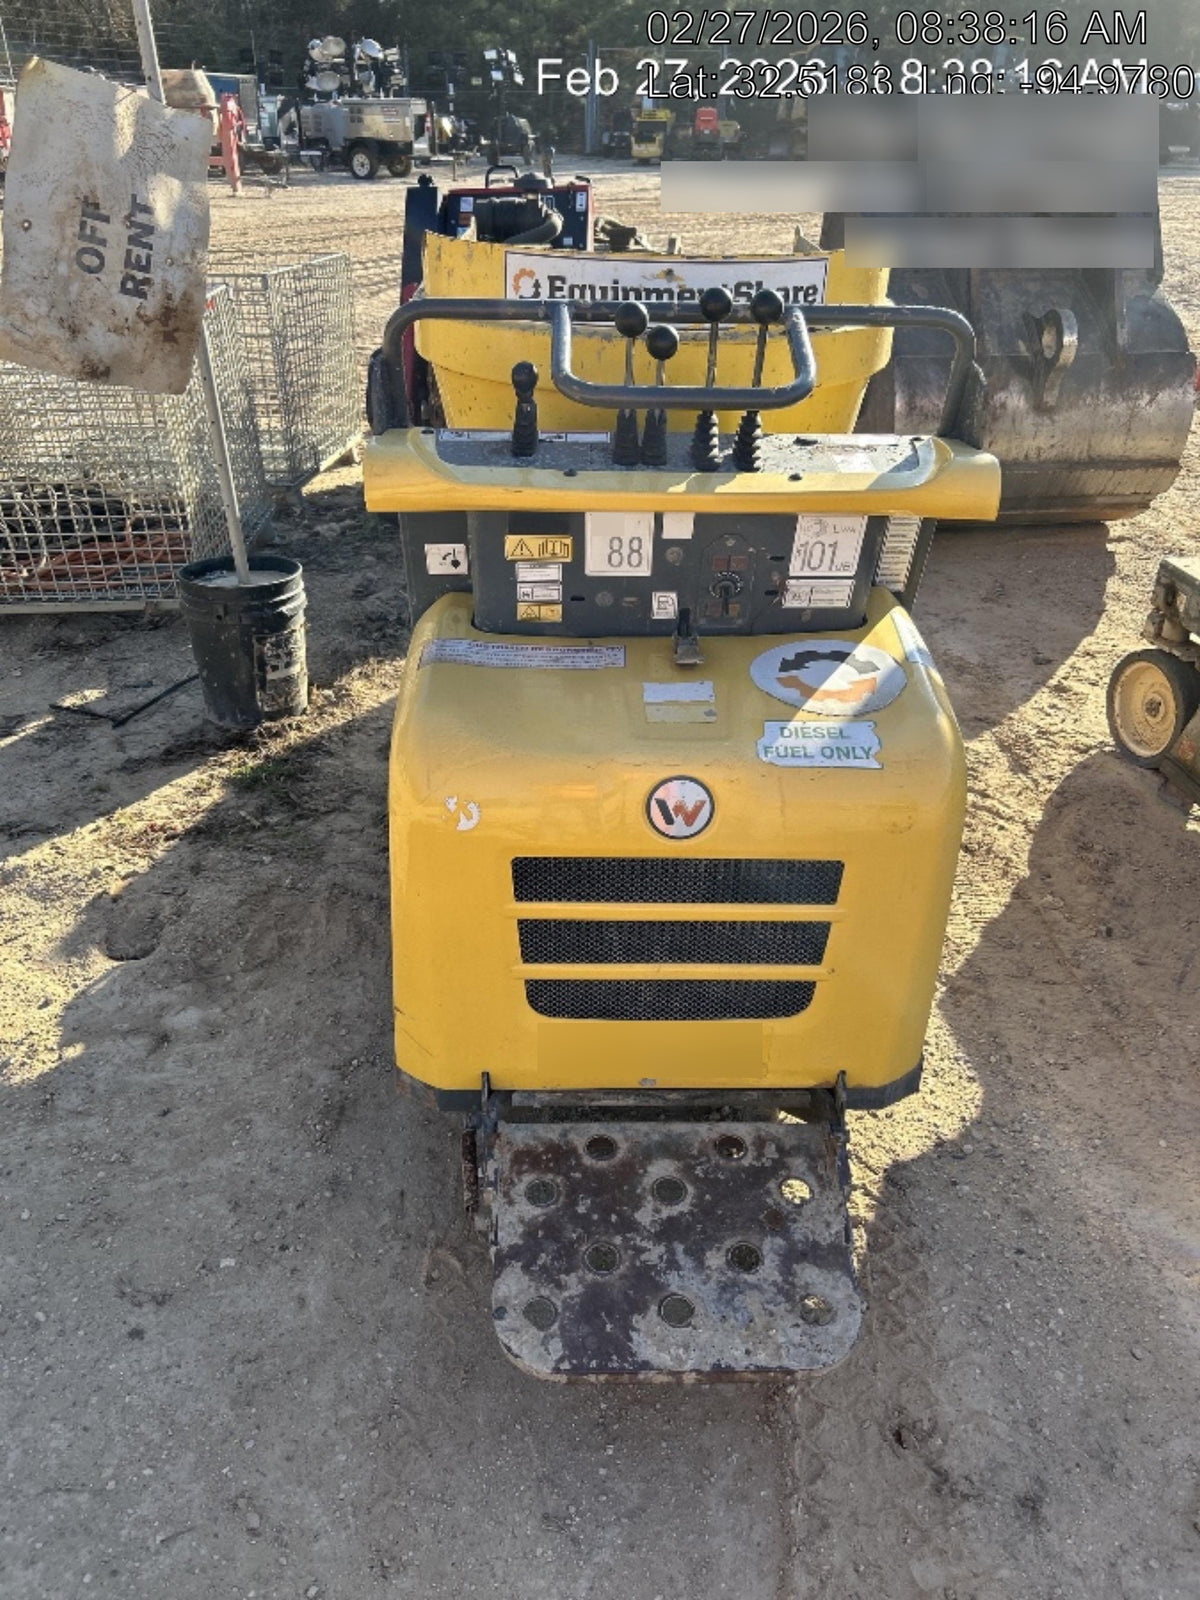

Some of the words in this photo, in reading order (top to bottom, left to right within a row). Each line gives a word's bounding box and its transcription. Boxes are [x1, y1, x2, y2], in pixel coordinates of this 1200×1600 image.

[76, 195, 110, 274] OFF
[120, 193, 155, 300] RENT
[607, 536, 643, 568] 88
[798, 540, 839, 571] 101
[779, 726, 851, 740] DIESEL
[763, 744, 815, 760] FUEL
[820, 745, 874, 760] ONLY
